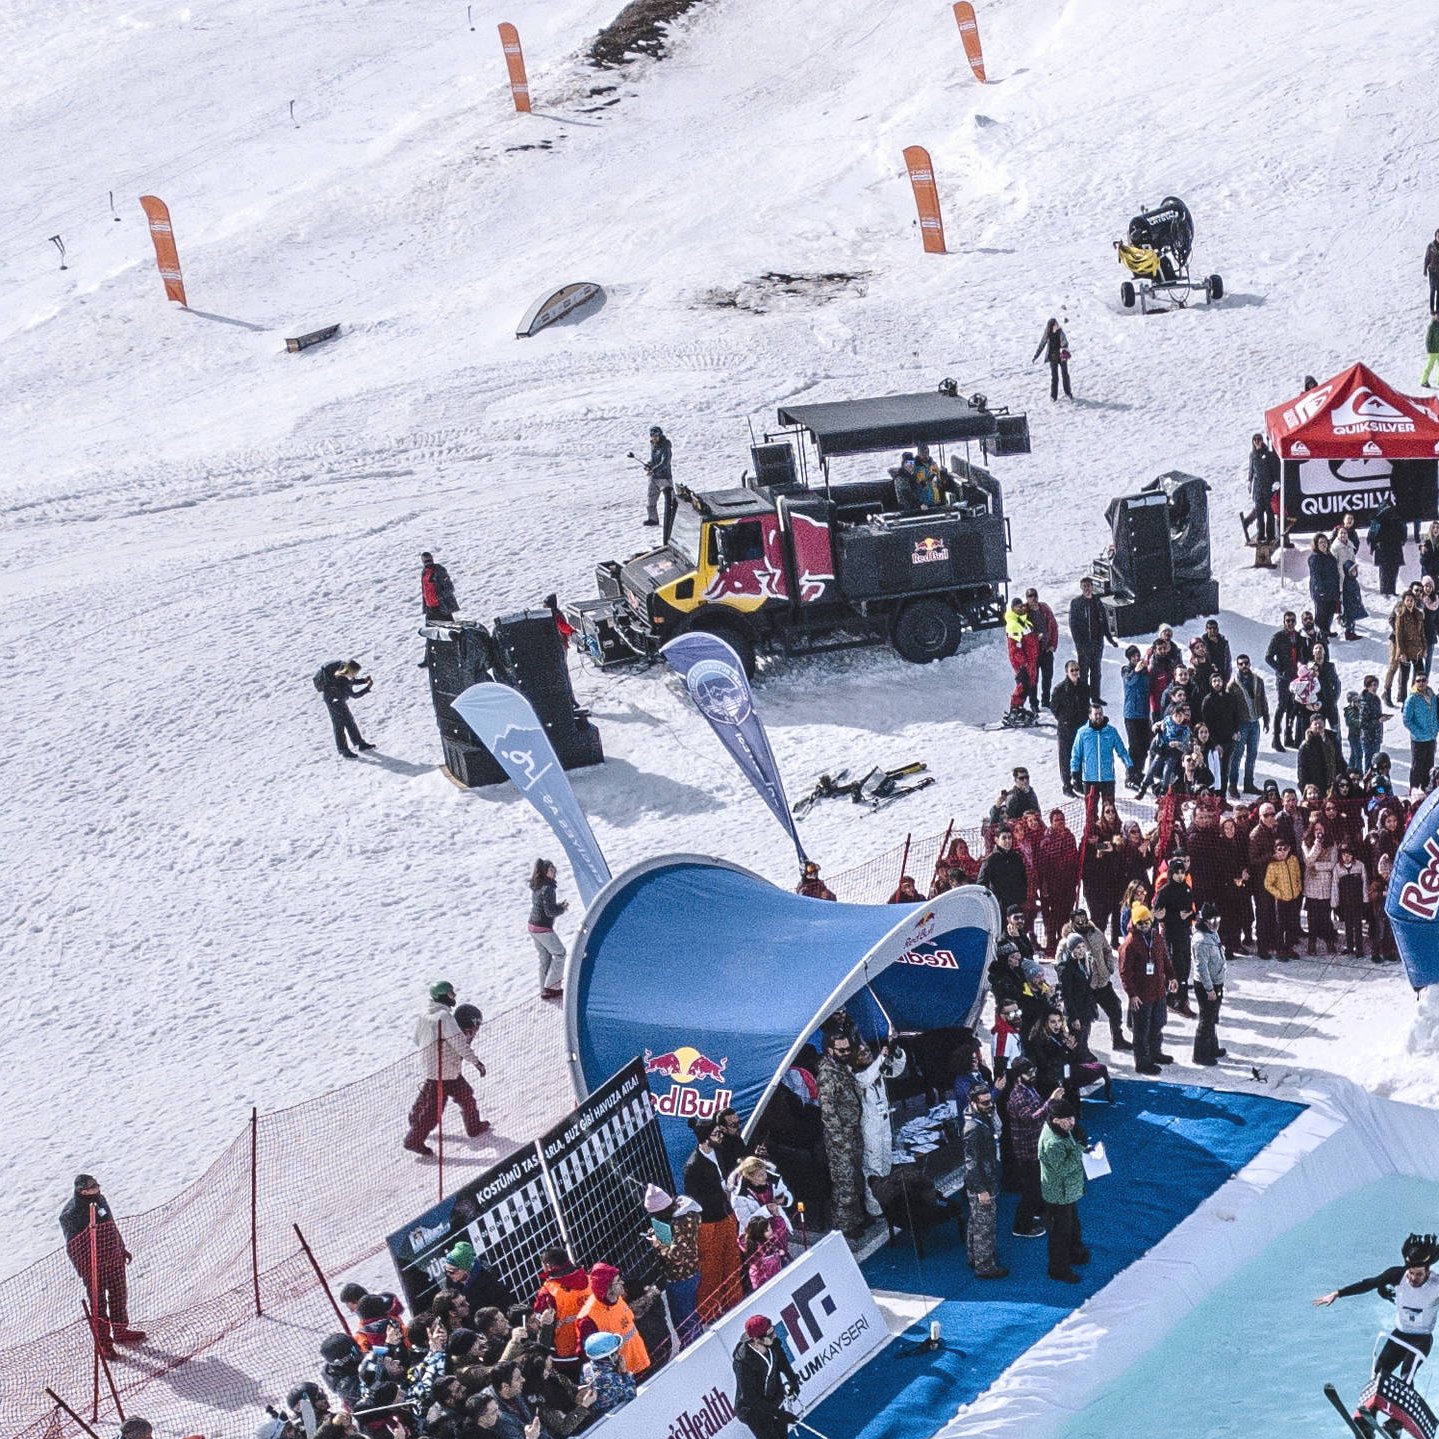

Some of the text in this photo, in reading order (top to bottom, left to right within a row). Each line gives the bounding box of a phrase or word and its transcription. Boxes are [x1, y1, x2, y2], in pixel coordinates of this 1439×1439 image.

[1333, 421, 1416, 435] QUIKSILVER
[1301, 491, 1397, 515] QUIKSILV
[649, 1085, 732, 1120] ed Bull
[475, 1162, 523, 1206] KOSTÜMÜ
[564, 1124, 580, 1144] BUZ
[580, 1108, 595, 1131] GİBİ
[593, 1090, 622, 1119] HAVUZA
[621, 1074, 640, 1097] ATLA!
